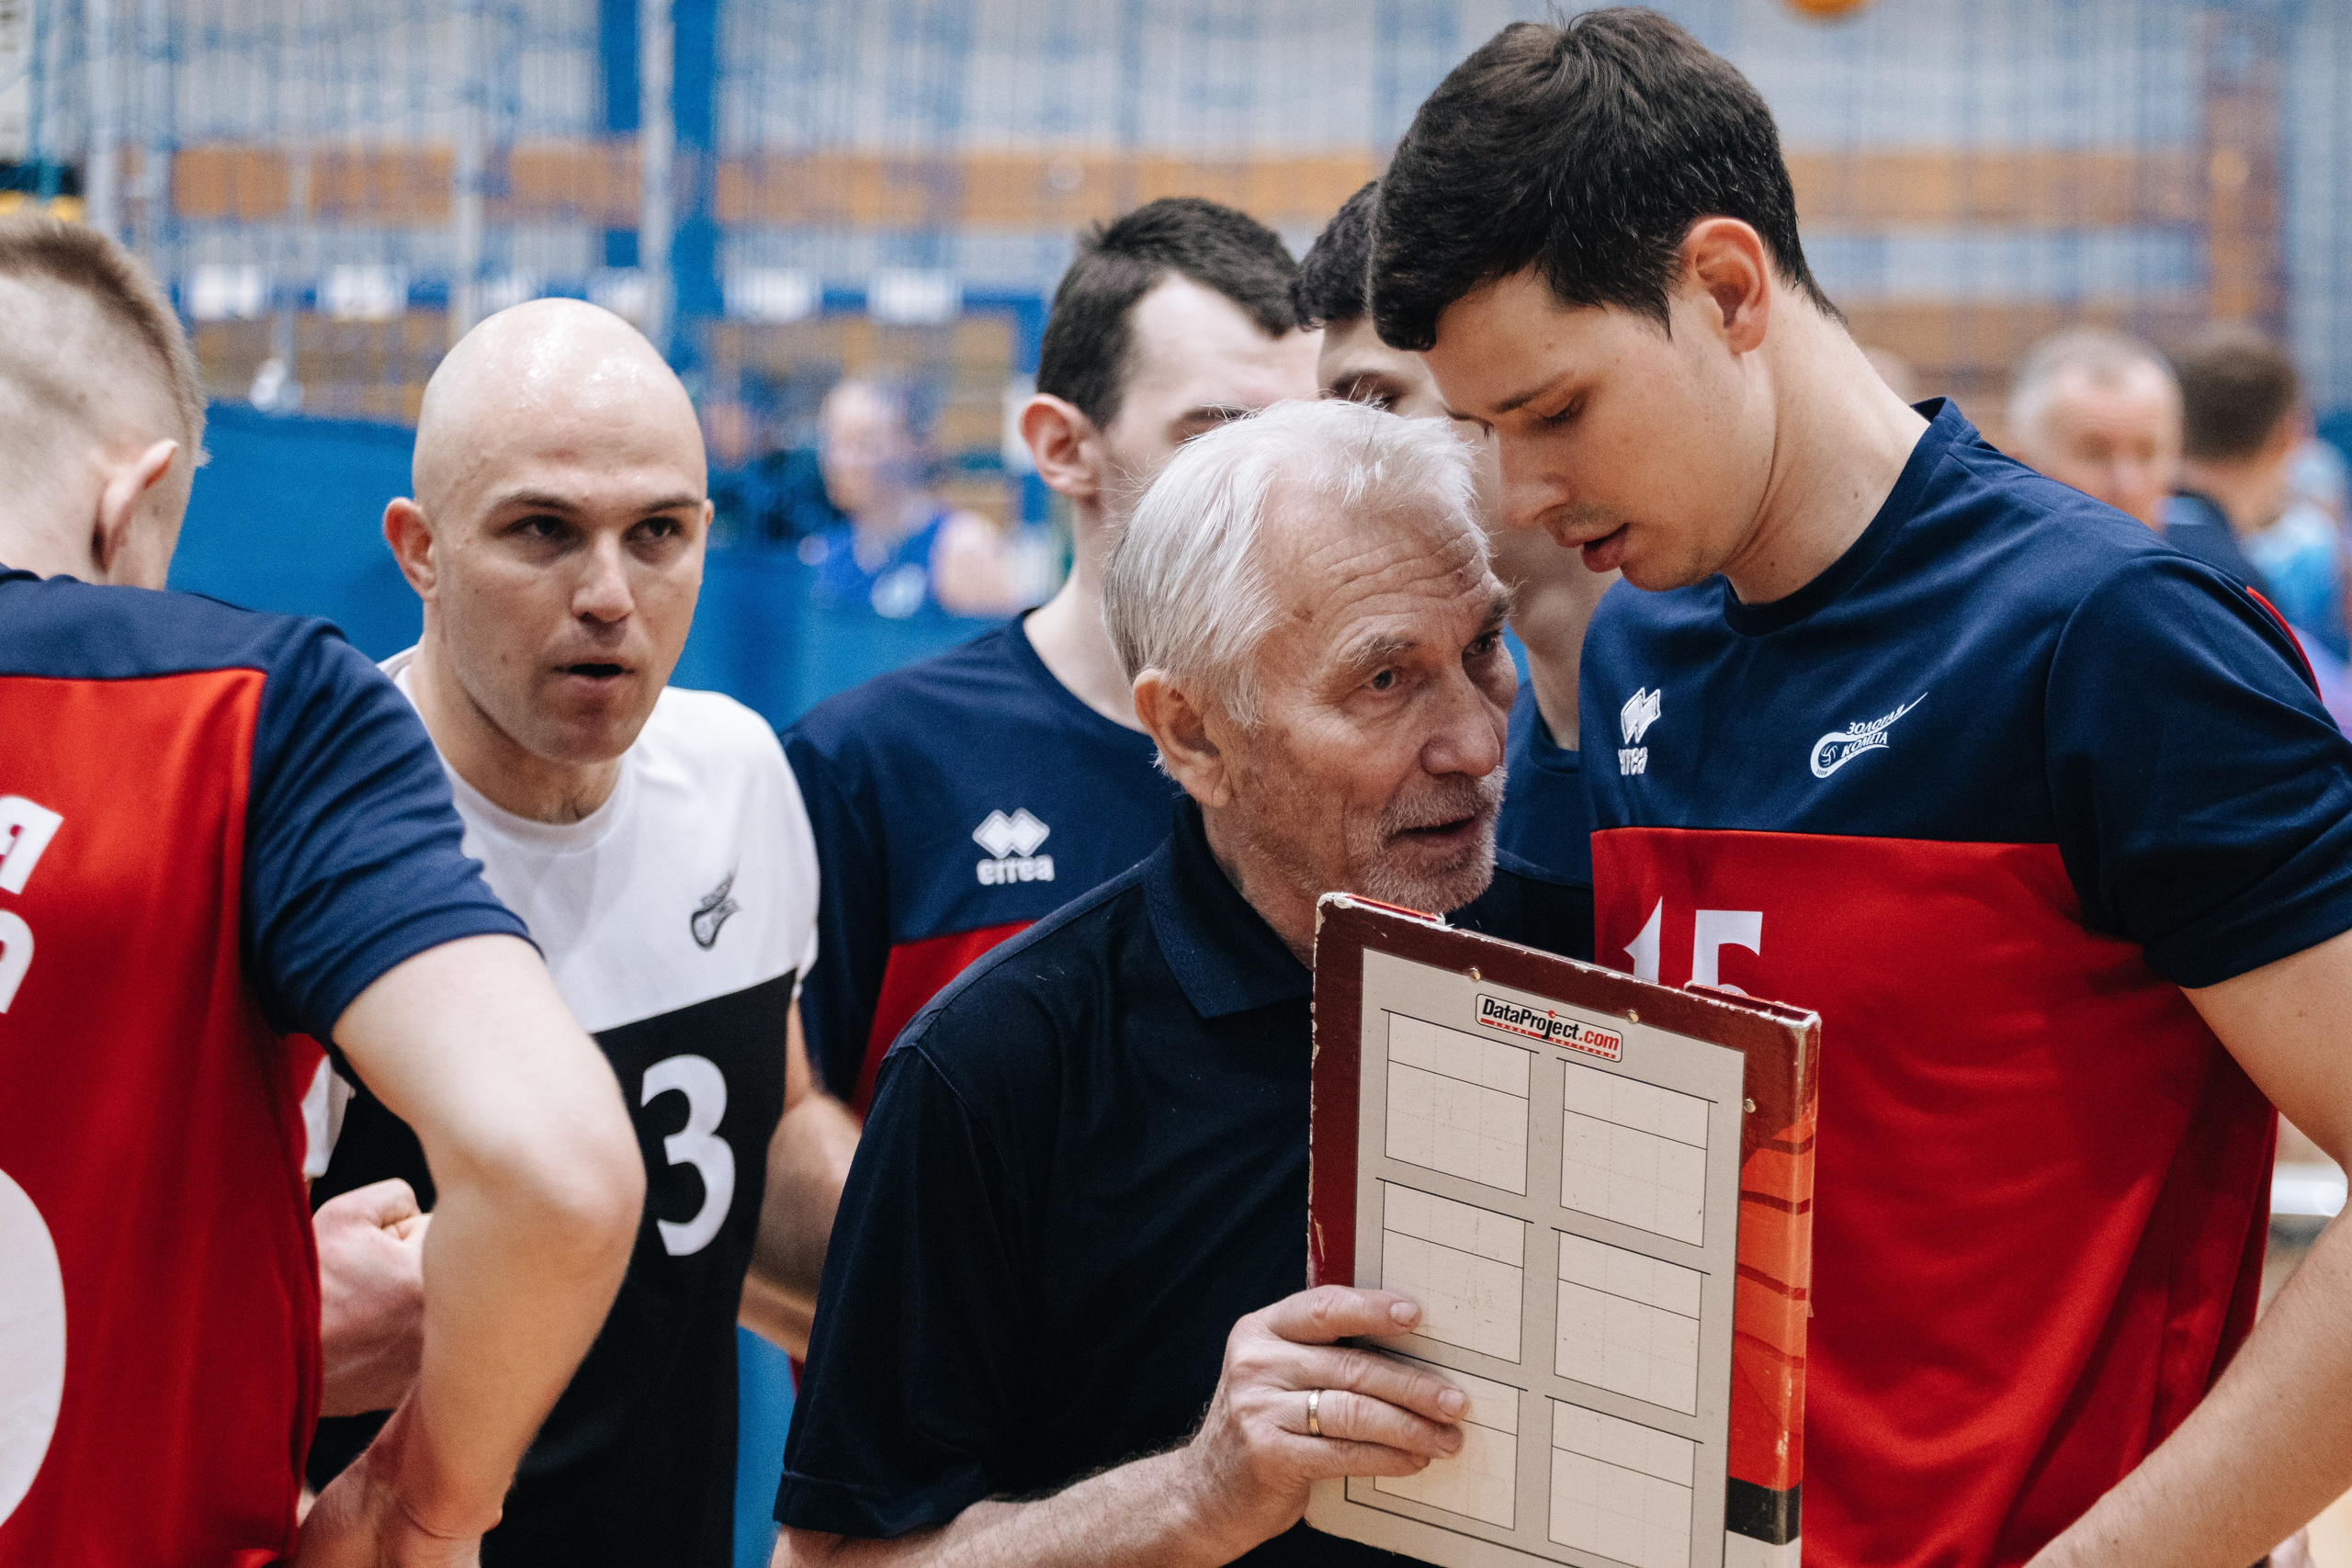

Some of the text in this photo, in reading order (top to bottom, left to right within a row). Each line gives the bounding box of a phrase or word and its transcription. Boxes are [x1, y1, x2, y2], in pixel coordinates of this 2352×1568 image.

[1847, 704, 1905, 736] ЗОЛОТАЯ
[1840, 732, 1888, 759] КОМЕТА
[976, 853, 1056, 886] errea
[1482, 998, 1620, 1052] DataProject.com
[640, 1054, 736, 1257] 3
